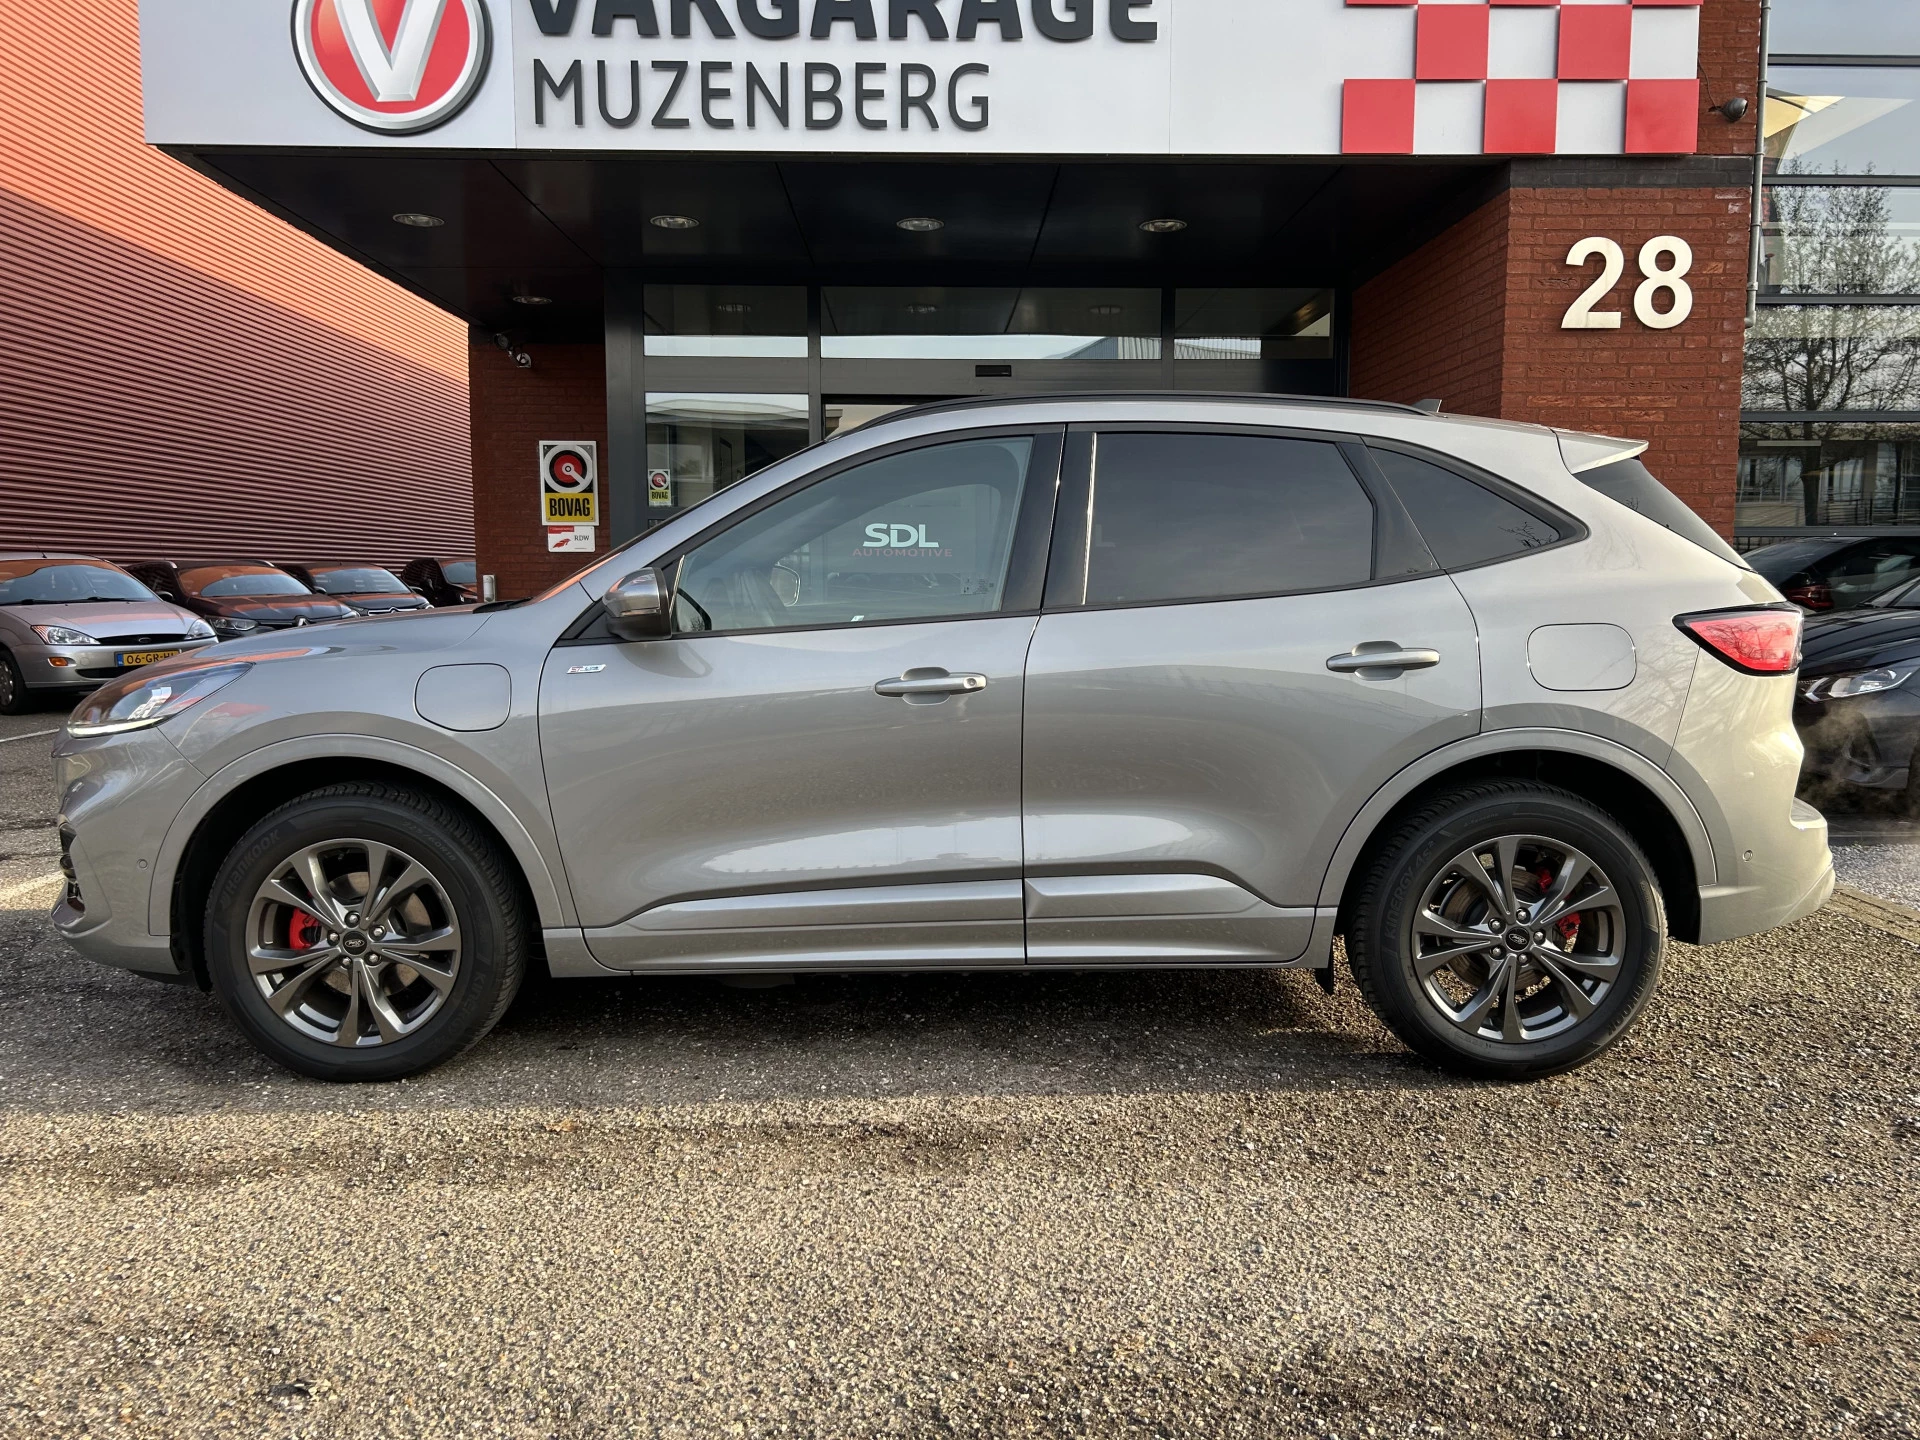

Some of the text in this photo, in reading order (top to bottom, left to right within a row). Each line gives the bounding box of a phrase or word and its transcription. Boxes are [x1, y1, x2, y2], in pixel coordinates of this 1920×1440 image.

[533, 58, 989, 131] MUZENBERG
[1561, 235, 1693, 329] 28
[651, 491, 669, 499] BOVAG
[549, 497, 591, 517] BOVAG
[862, 523, 940, 548] SDL
[852, 549, 953, 557] AUTOMOTIVE
[126, 653, 174, 665] 06-GR-H
